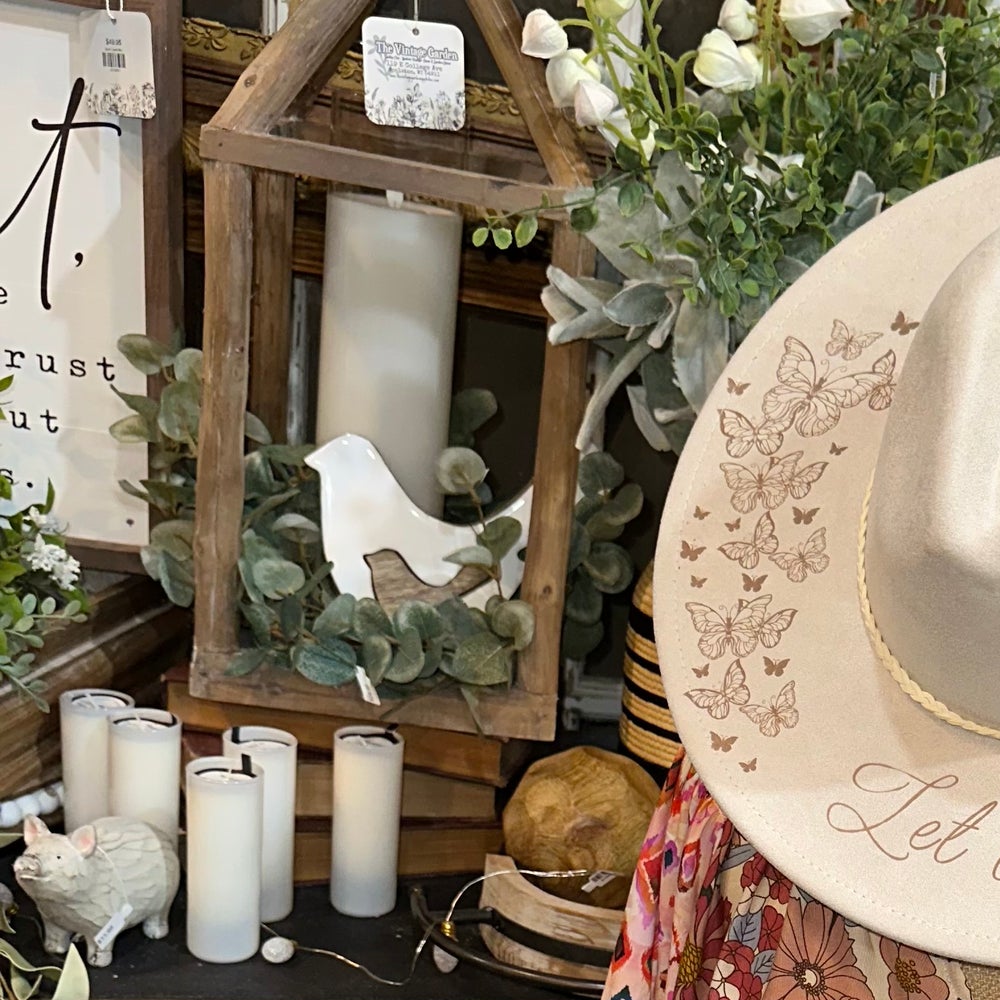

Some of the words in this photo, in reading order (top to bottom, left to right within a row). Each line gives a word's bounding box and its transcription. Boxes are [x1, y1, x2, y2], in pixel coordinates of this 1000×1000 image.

[375, 40, 393, 54] The
[394, 42, 427, 59] Vintage
[427, 46, 459, 61] Garden
[4, 349, 116, 382] rust
[9, 409, 59, 434] ut
[827, 762, 998, 864] Let
